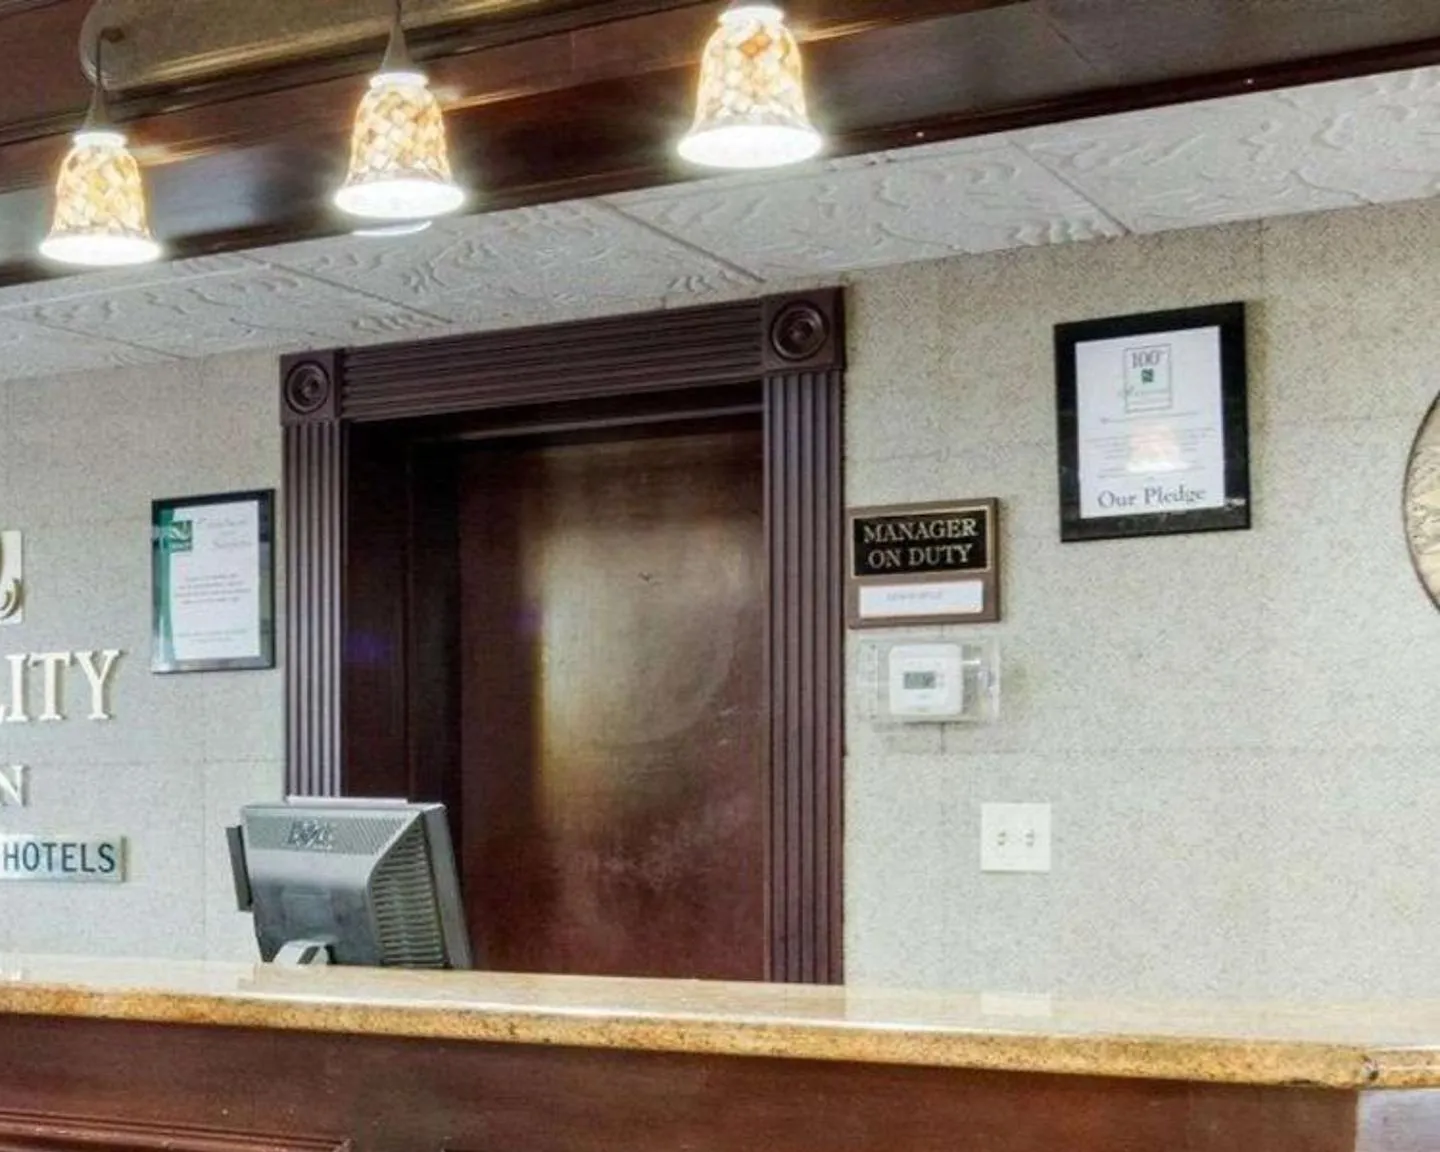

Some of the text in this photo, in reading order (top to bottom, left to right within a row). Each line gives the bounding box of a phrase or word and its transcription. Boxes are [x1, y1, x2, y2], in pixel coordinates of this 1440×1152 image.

[1097, 490, 1136, 509] Our
[864, 518, 978, 543] MANAGER
[868, 543, 973, 568] ON DUTY
[3, 842, 115, 873] HOTELS
